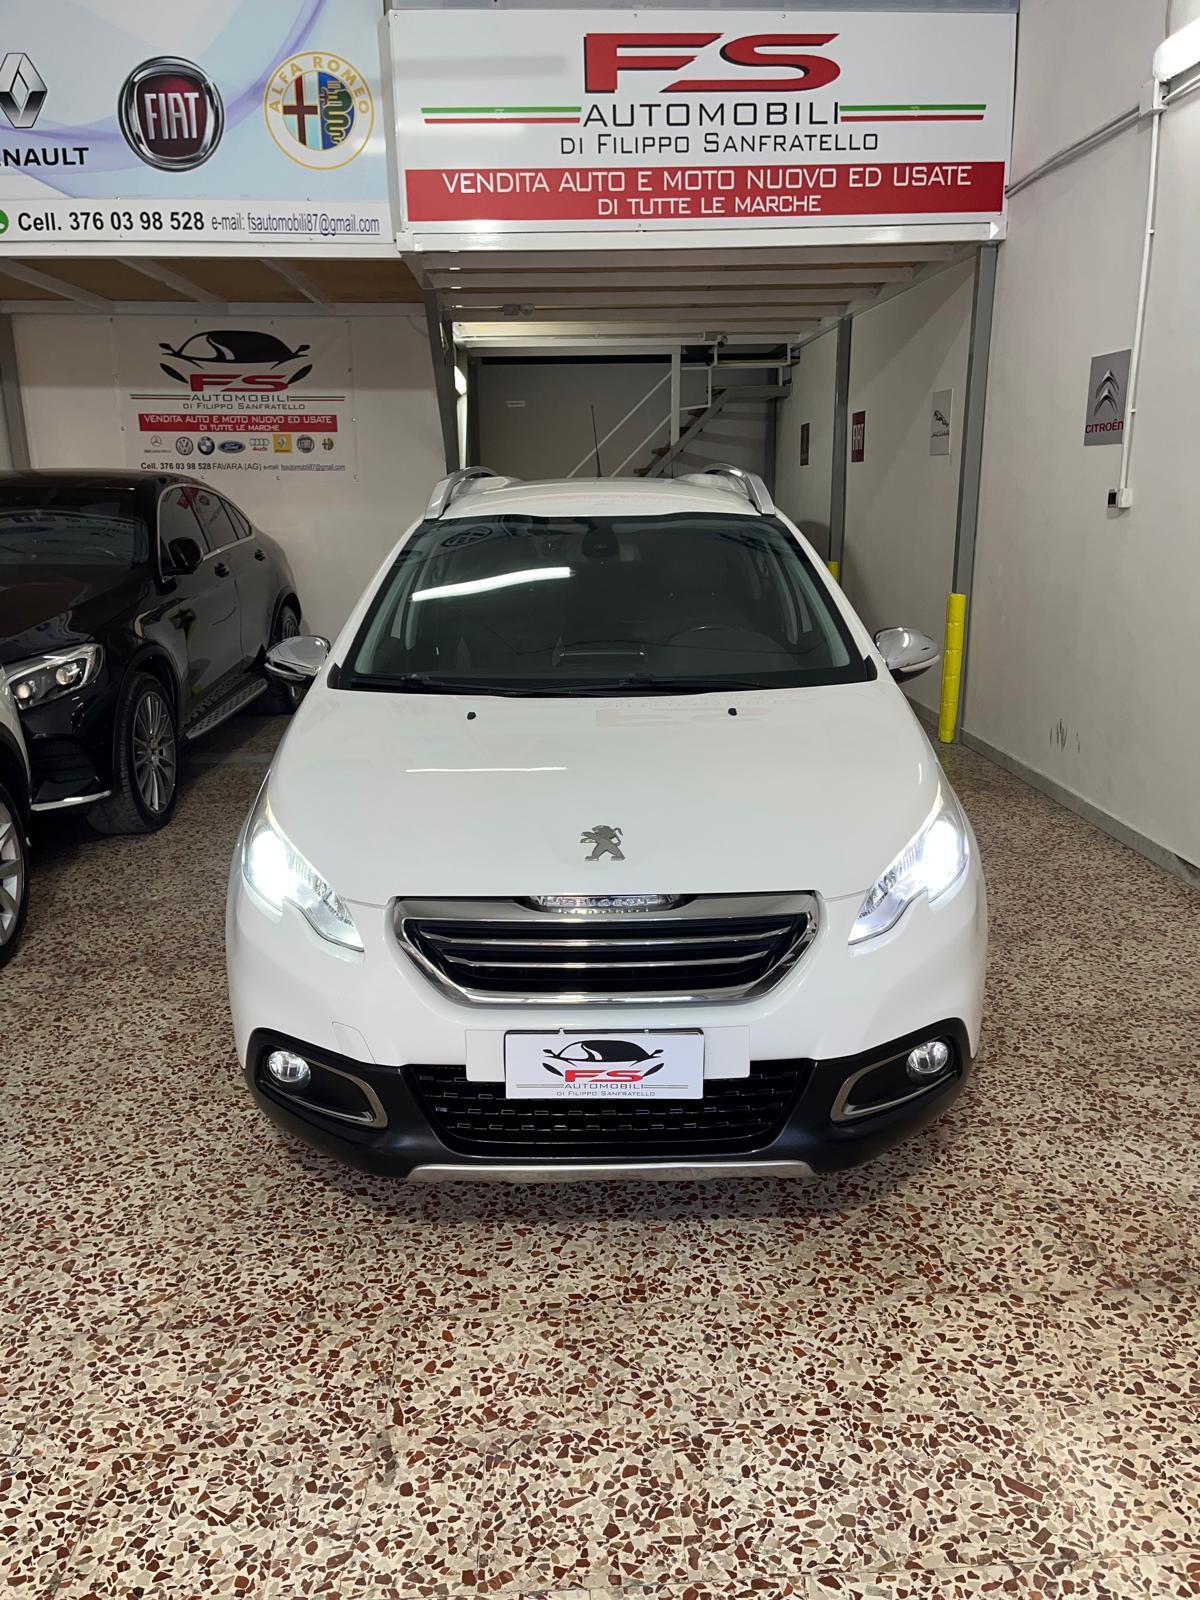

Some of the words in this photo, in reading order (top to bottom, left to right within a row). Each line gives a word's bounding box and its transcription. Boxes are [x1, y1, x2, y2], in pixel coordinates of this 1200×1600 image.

[584, 33, 840, 93] FS
[269, 62, 302, 113] ALFA
[312, 56, 369, 114] ROMEO
[144, 92, 199, 140] FIAT
[583, 102, 838, 127] AUTOMOBILI
[561, 137, 583, 154] DI
[598, 134, 689, 154] FILIPPO
[704, 132, 878, 153] SANFRATELLO
[442, 172, 550, 194] VENDITA
[559, 171, 625, 192] AUTO
[638, 171, 652, 191] E
[664, 170, 734, 190] MOTO
[747, 168, 836, 189] NUOVO
[849, 167, 882, 188] ED
[894, 165, 972, 186] USATE
[598, 198, 618, 215] DI
[627, 197, 691, 215] TUTTE
[701, 197, 725, 213] LE
[735, 195, 821, 212] MARCHE
[18, 212, 62, 231] Cell.
[69, 212, 104, 231] 376
[110, 211, 133, 230] 03
[140, 211, 163, 230] 98
[170, 211, 204, 230] 528
[211, 212, 245, 231] e-mail:
[247, 212, 380, 236] fsautomobili87@gmail.com
[190, 374, 288, 392] FS
[191, 394, 289, 402] AUTOMOBILI
[144, 415, 182, 423] VENDITA
[185, 415, 209, 423] AUTO
[213, 415, 219, 423] E
[222, 415, 248, 423] MOTO
[251, 415, 285, 424] NUOVO
[288, 416, 300, 424] ED
[303, 416, 332, 424] USATE
[140, 462, 158, 470] Cell.
[160, 462, 174, 470] 376
[176, 462, 185, 470] 03
[187, 462, 196, 470] 98
[198, 462, 211, 470] 528
[244, 463, 262, 471] (AG)
[565, 1070, 643, 1082] FS
